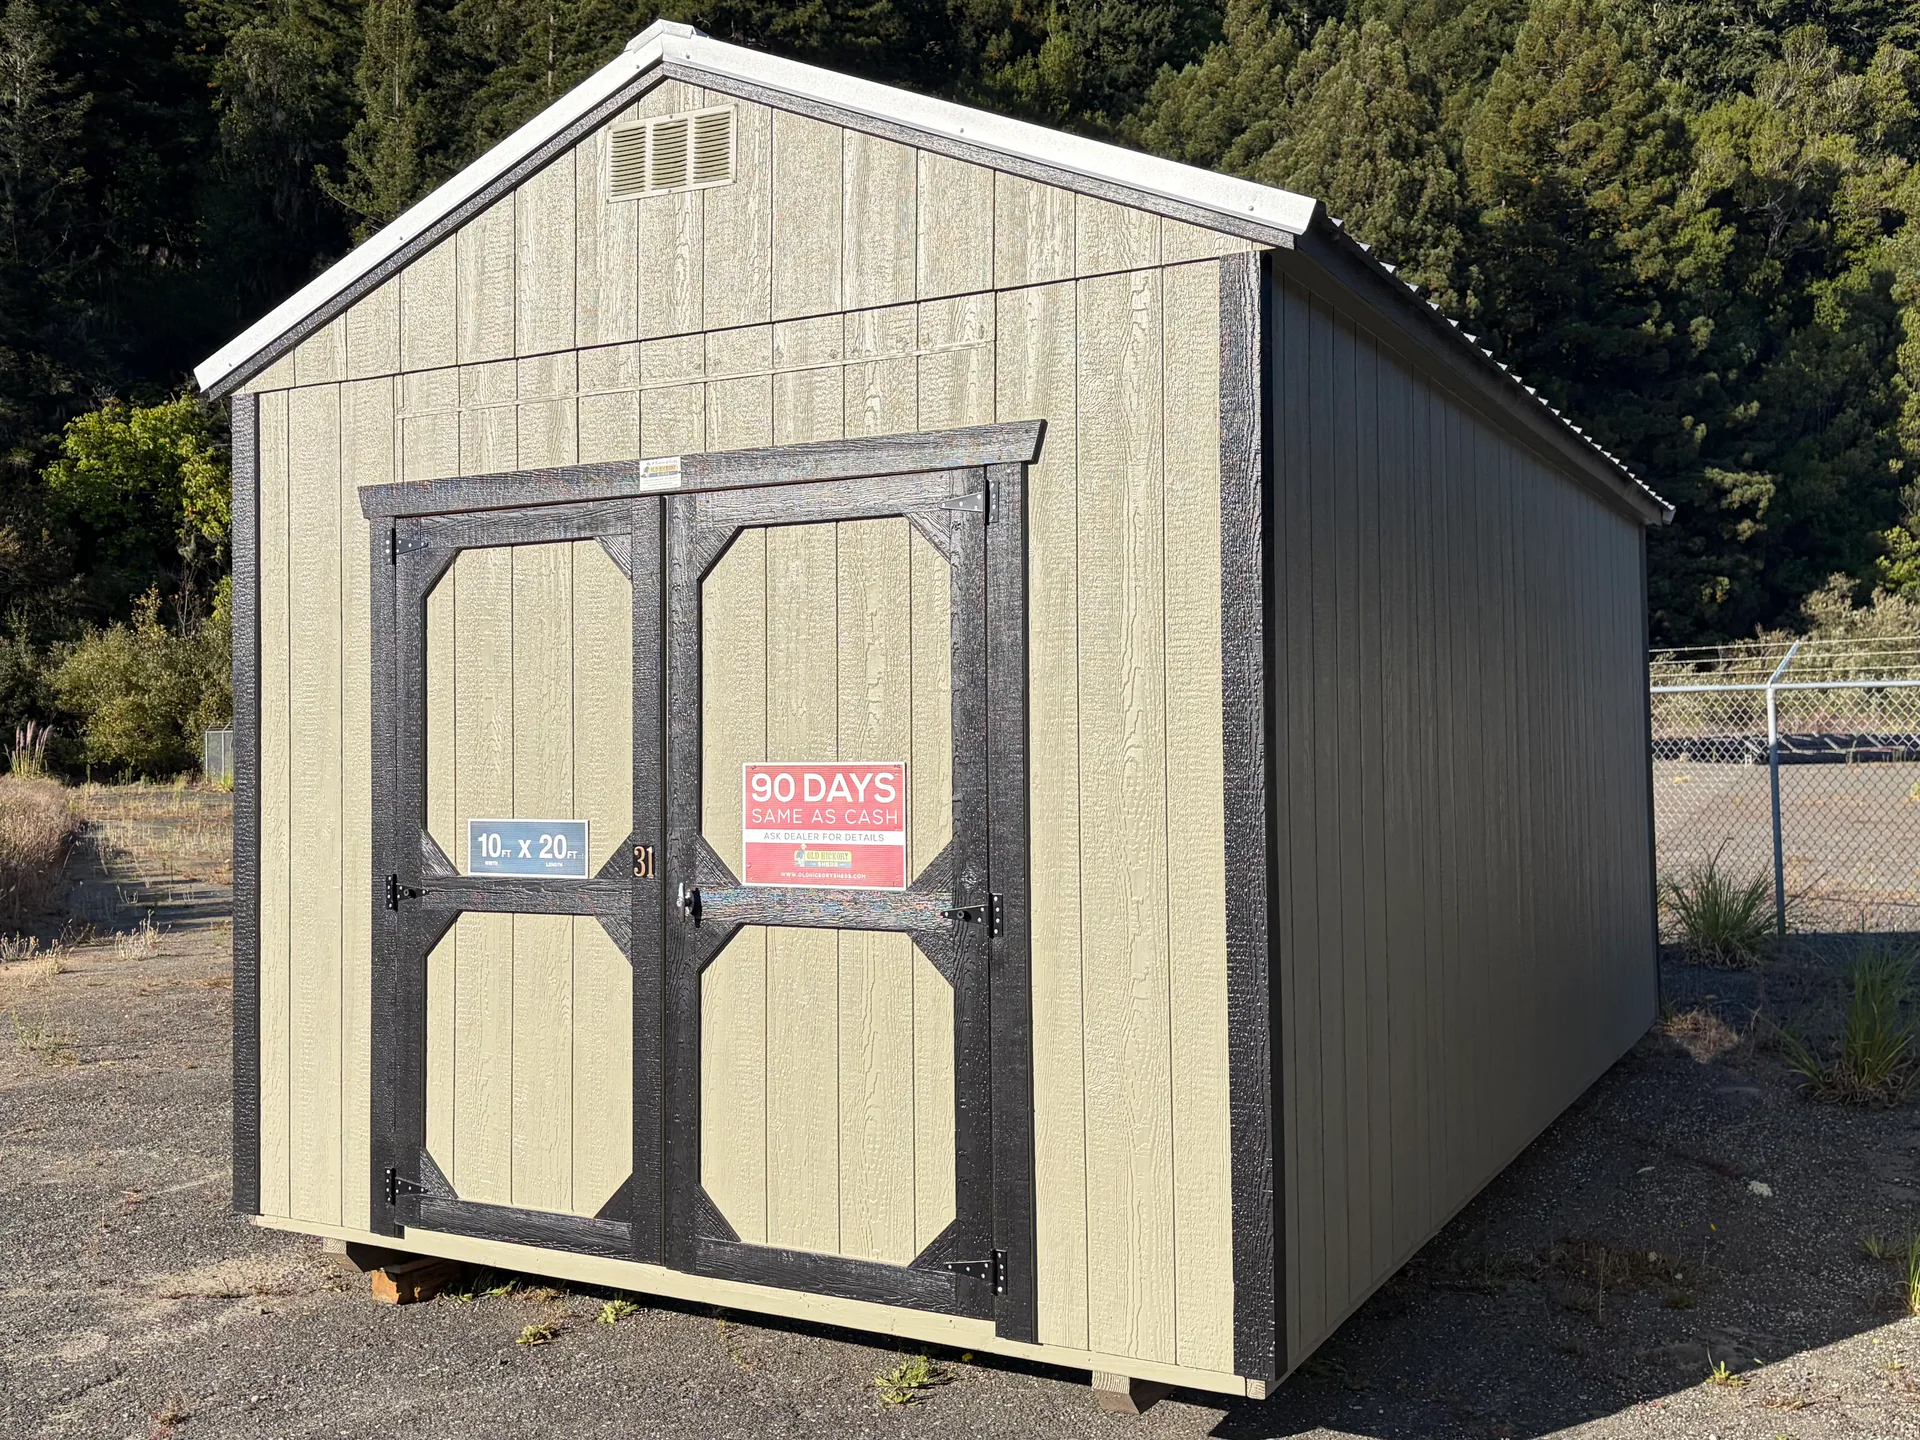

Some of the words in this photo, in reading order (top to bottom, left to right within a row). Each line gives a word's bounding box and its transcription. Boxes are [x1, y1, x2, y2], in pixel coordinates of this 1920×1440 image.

[751, 772, 795, 803] 90
[803, 772, 896, 803] DAYS
[751, 808, 803, 825] SAME
[811, 809, 836, 825] AS
[844, 809, 899, 826] CASH
[763, 832, 781, 841] ASK
[784, 832, 820, 842] DEALER
[822, 833, 842, 842] FOR
[845, 833, 885, 843] DETAILS
[633, 845, 654, 879] 31
[806, 851, 820, 860] OLD
[821, 851, 849, 861] HICKORY
[780, 871, 867, 880] WWW.OLDHICKORYSHEDS.COM
